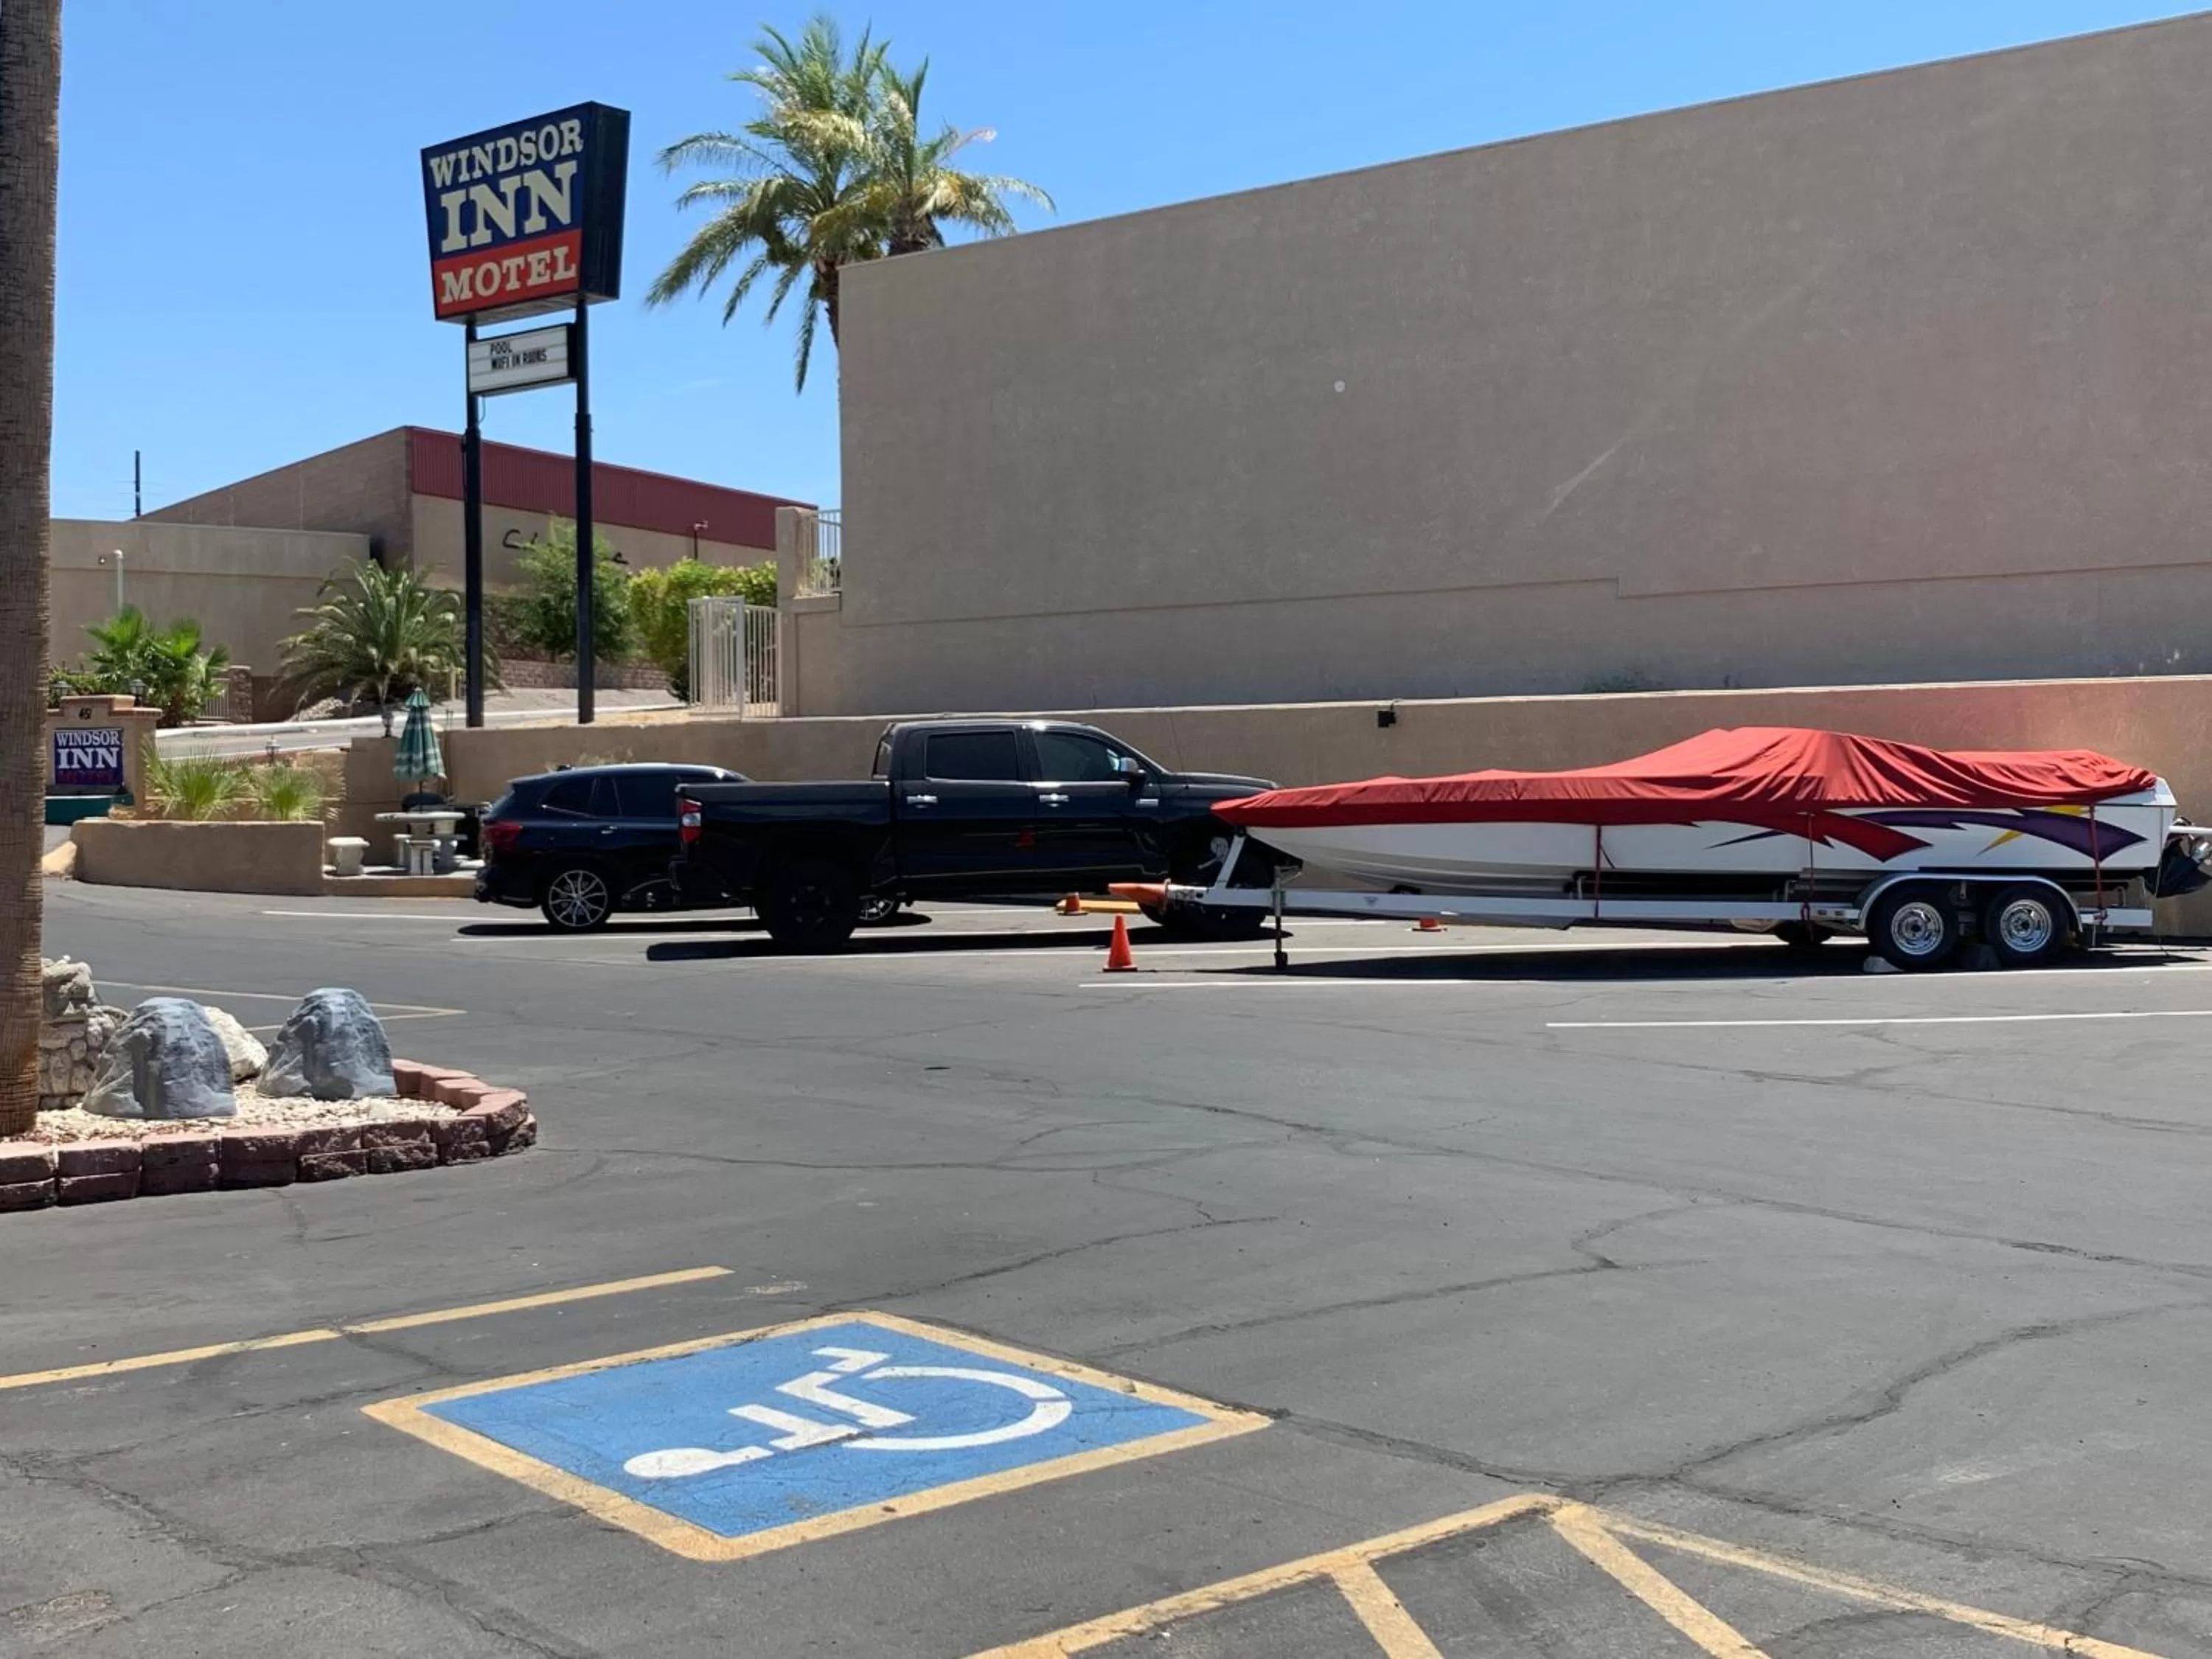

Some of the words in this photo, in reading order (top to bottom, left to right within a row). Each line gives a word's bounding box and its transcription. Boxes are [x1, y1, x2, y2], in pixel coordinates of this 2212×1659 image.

[430, 118, 584, 189] WINDSOR
[440, 160, 578, 254] INN
[442, 246, 577, 305] MOTEL
[56, 731, 120, 746] WINDSOR
[57, 747, 120, 769] INN
